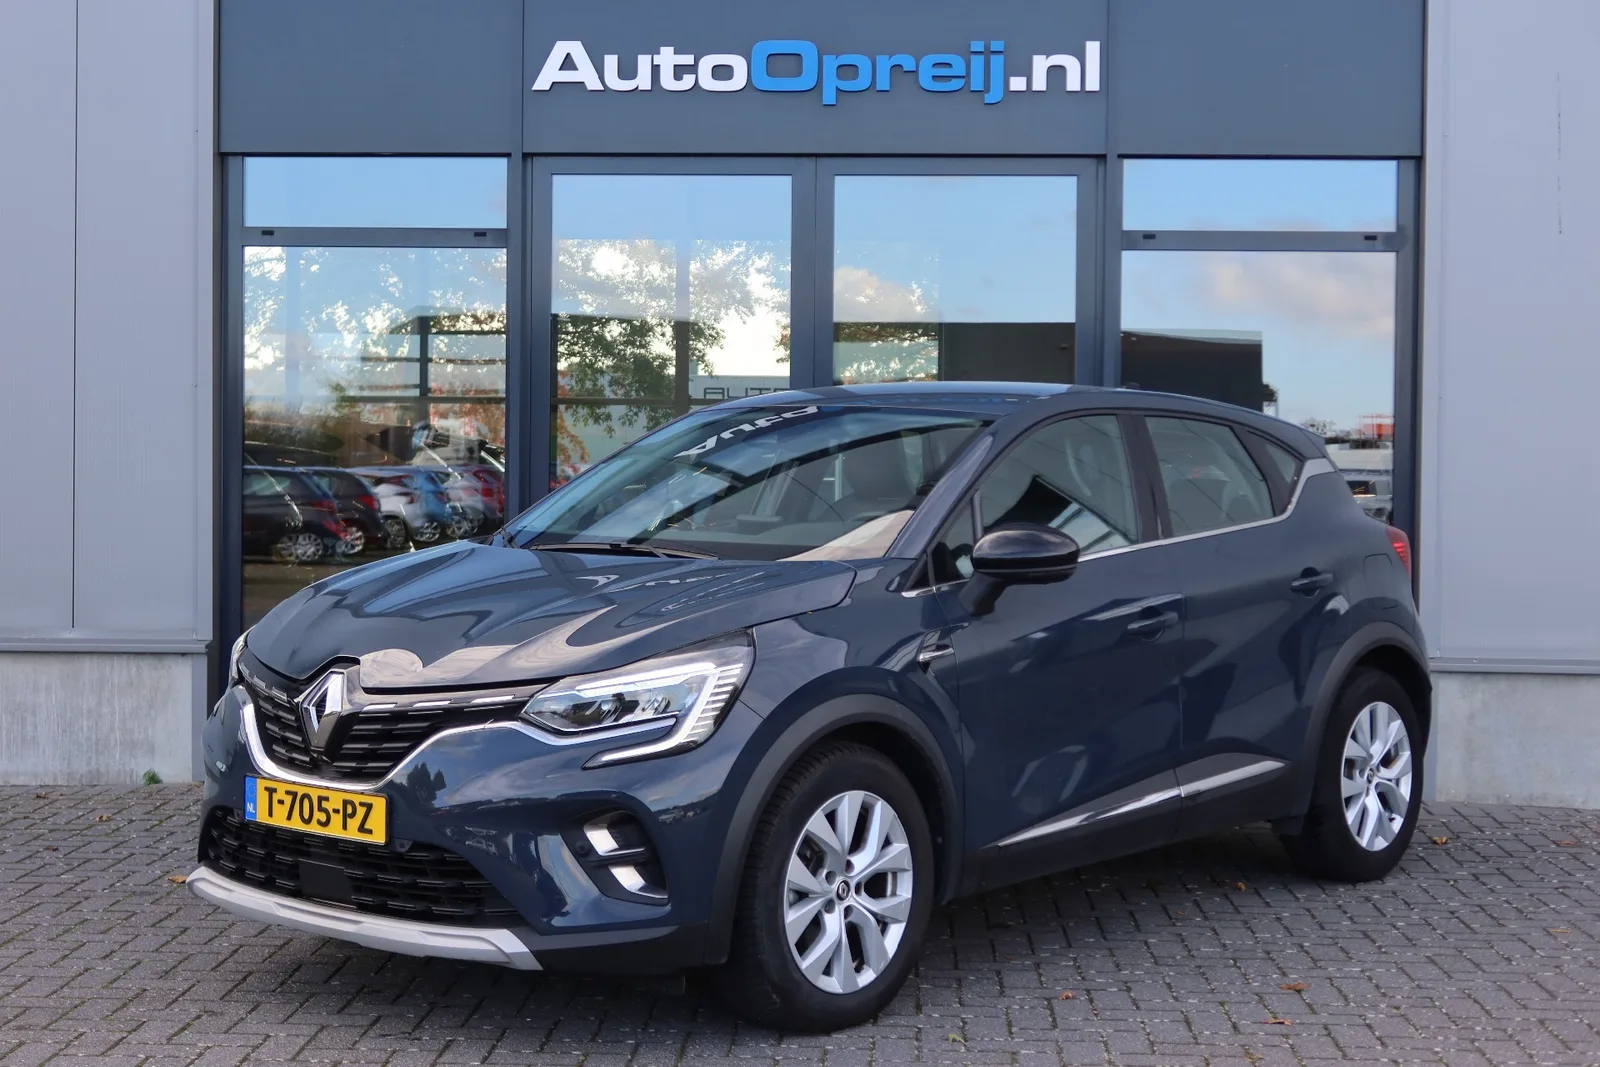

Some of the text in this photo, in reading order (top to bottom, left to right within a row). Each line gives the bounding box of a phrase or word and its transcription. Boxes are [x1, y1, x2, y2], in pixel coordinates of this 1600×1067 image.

[531, 39, 1101, 105] AutoOpreij.nl
[246, 802, 256, 813] NL
[264, 786, 373, 835] T-705-PZ
